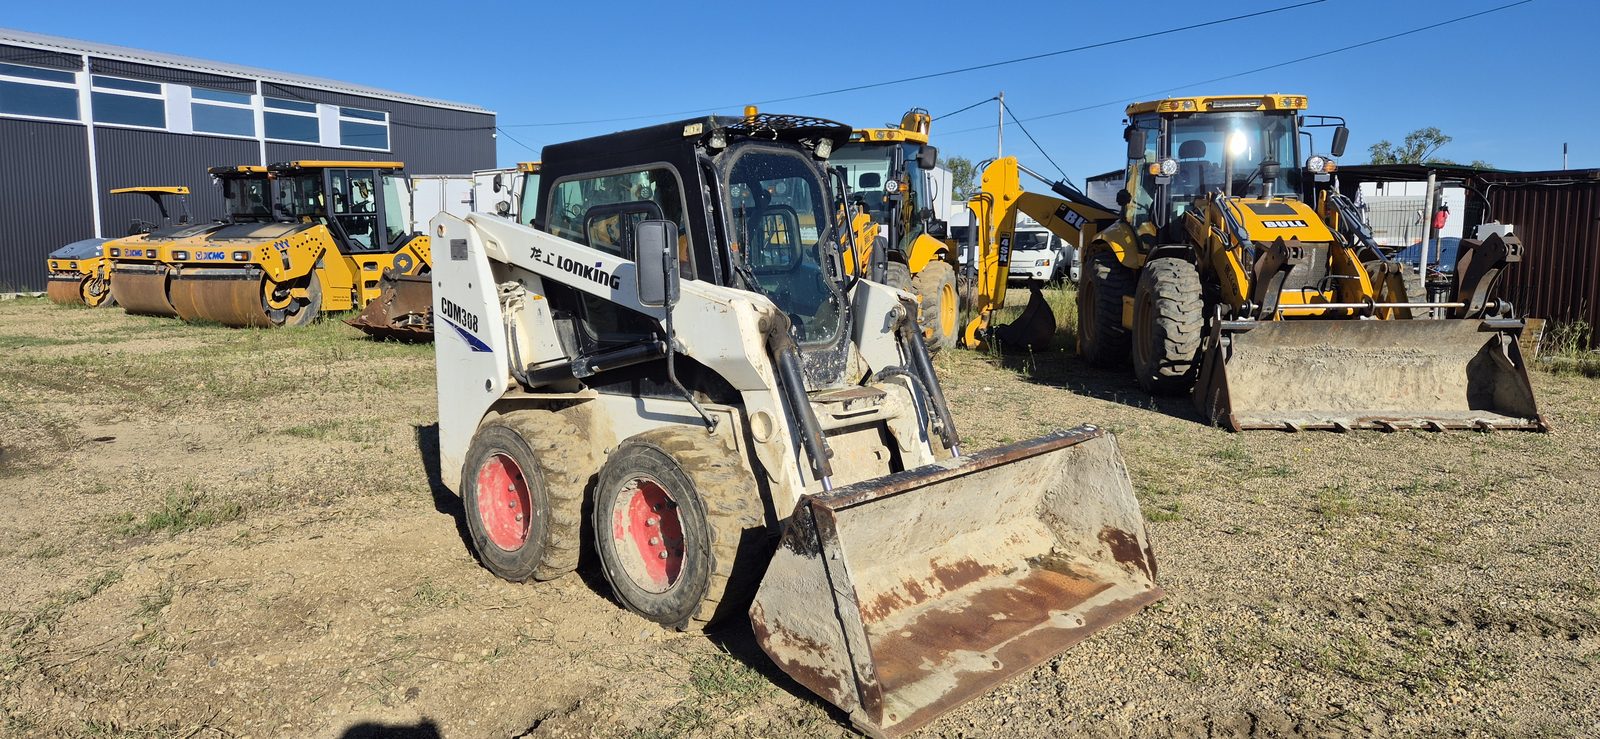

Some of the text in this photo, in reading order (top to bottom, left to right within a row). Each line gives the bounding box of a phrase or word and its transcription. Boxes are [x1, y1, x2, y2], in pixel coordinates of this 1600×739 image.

[1064, 209, 1088, 229] BU
[1264, 220, 1306, 228] BULL
[441, 297, 479, 333] CDM308
